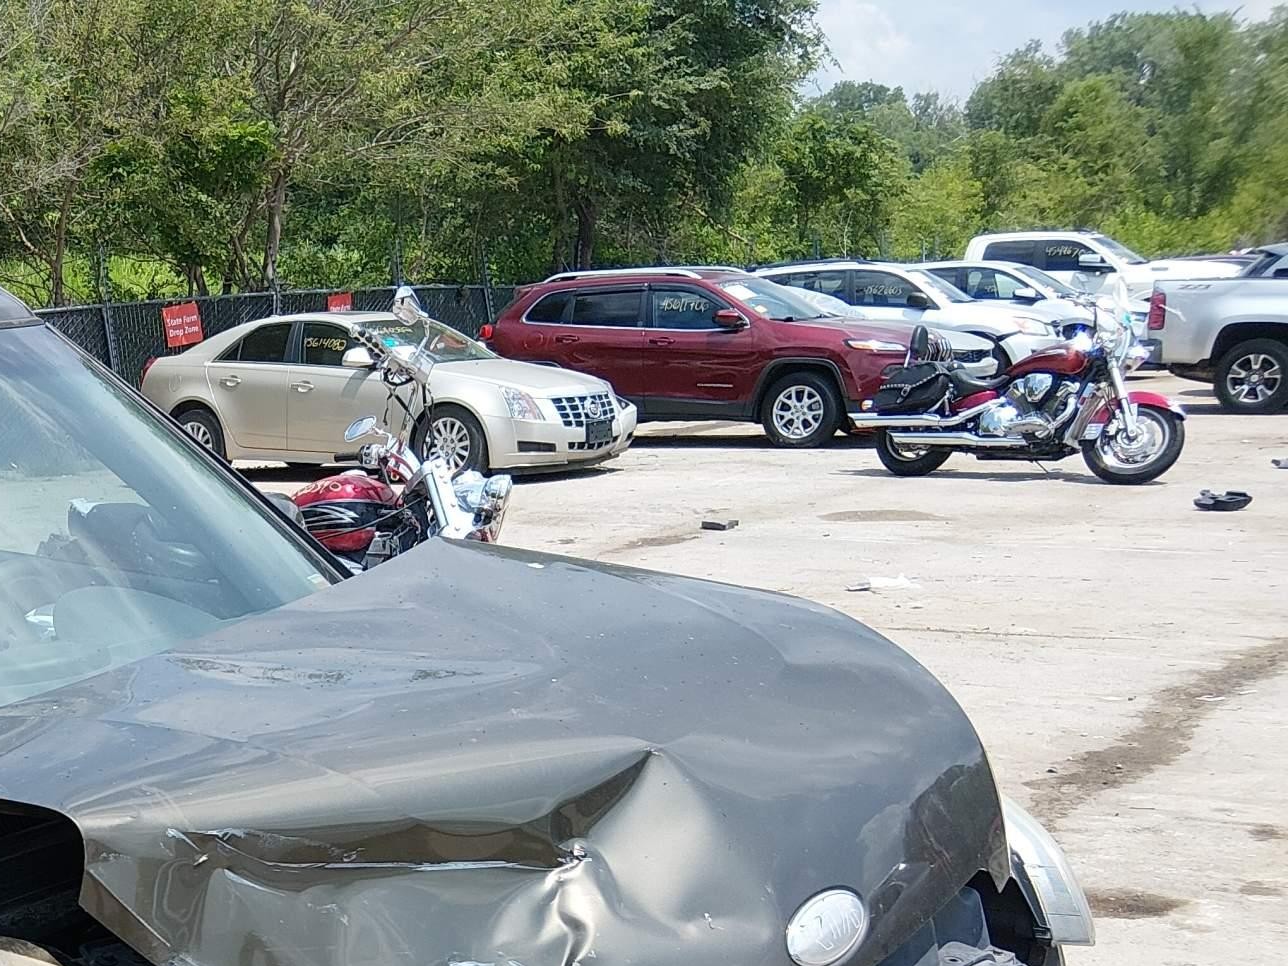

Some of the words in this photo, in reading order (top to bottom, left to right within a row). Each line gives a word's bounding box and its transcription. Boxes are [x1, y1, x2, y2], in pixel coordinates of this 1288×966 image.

[167, 315, 183, 327] State
[169, 328, 184, 338] Drop
[184, 325, 199, 335] Zone
